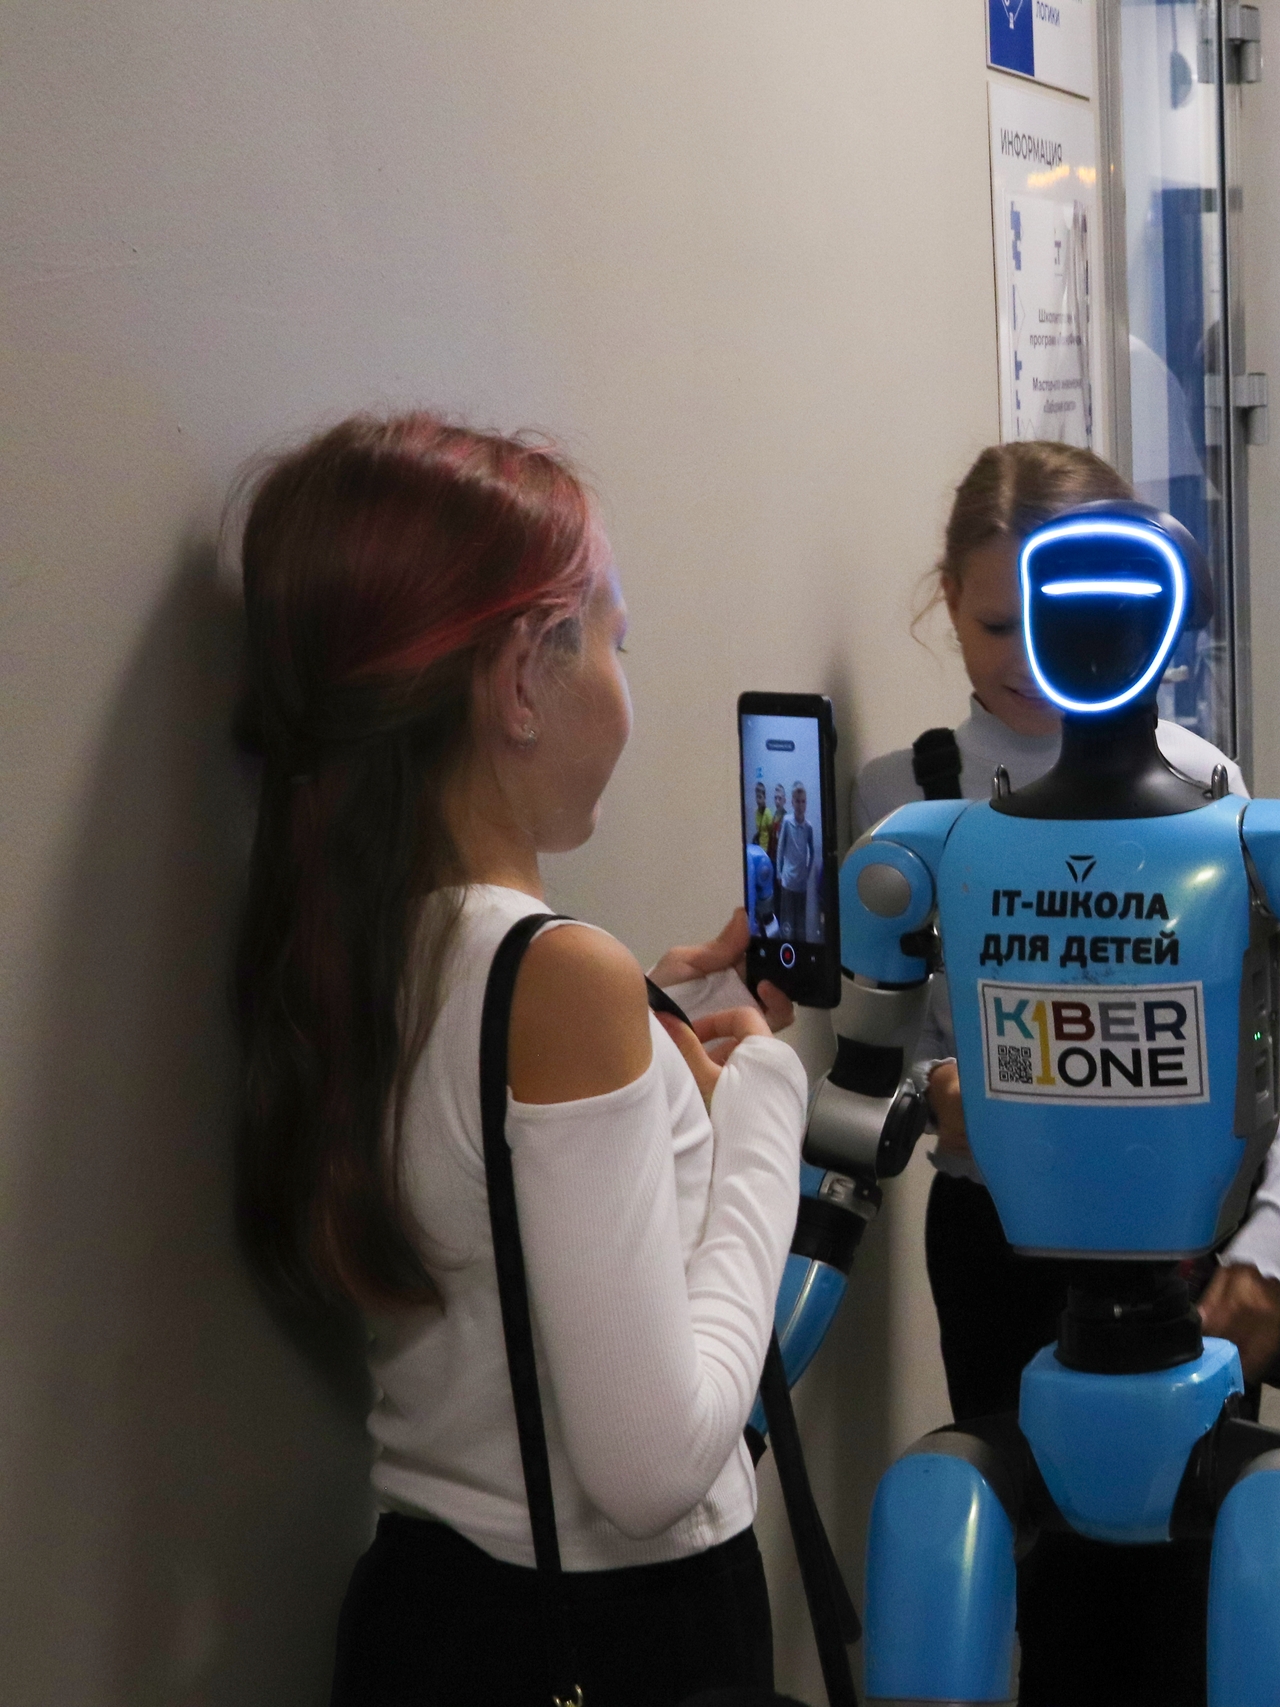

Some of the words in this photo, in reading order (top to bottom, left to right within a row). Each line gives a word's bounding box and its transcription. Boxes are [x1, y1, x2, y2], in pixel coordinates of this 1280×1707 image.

[1000, 128, 1063, 169] ИНФОРМАЦИЯ
[991, 889, 1169, 920] IT-ШКОЛА
[979, 933, 1050, 967] ДЛЯ
[1059, 930, 1180, 968] ДЕТЕЙ
[1057, 1046, 1188, 1087] ONE
